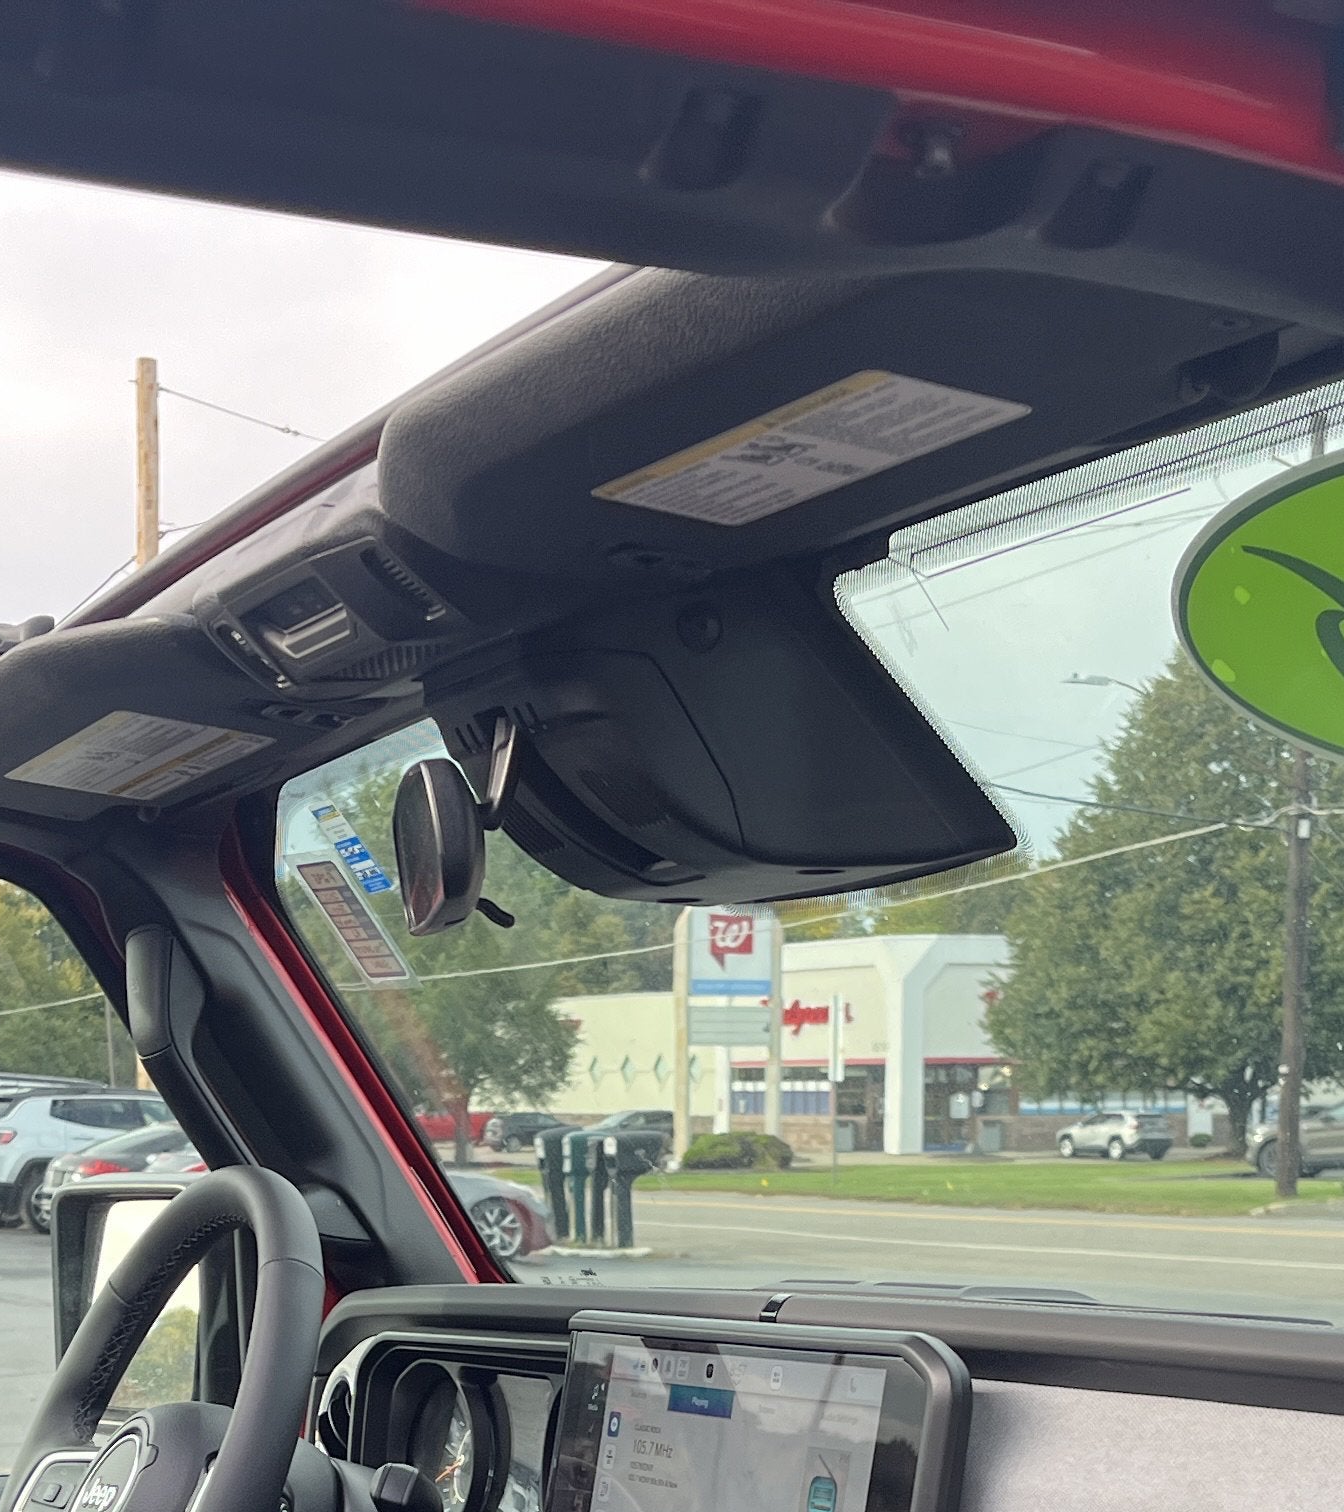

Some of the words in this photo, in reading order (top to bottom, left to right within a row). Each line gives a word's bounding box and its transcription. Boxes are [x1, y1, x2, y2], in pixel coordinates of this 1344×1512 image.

[632, 1438, 655, 1456] 105.7
[655, 1441, 674, 1459] MHz
[82, 1477, 118, 1512] Jeep
